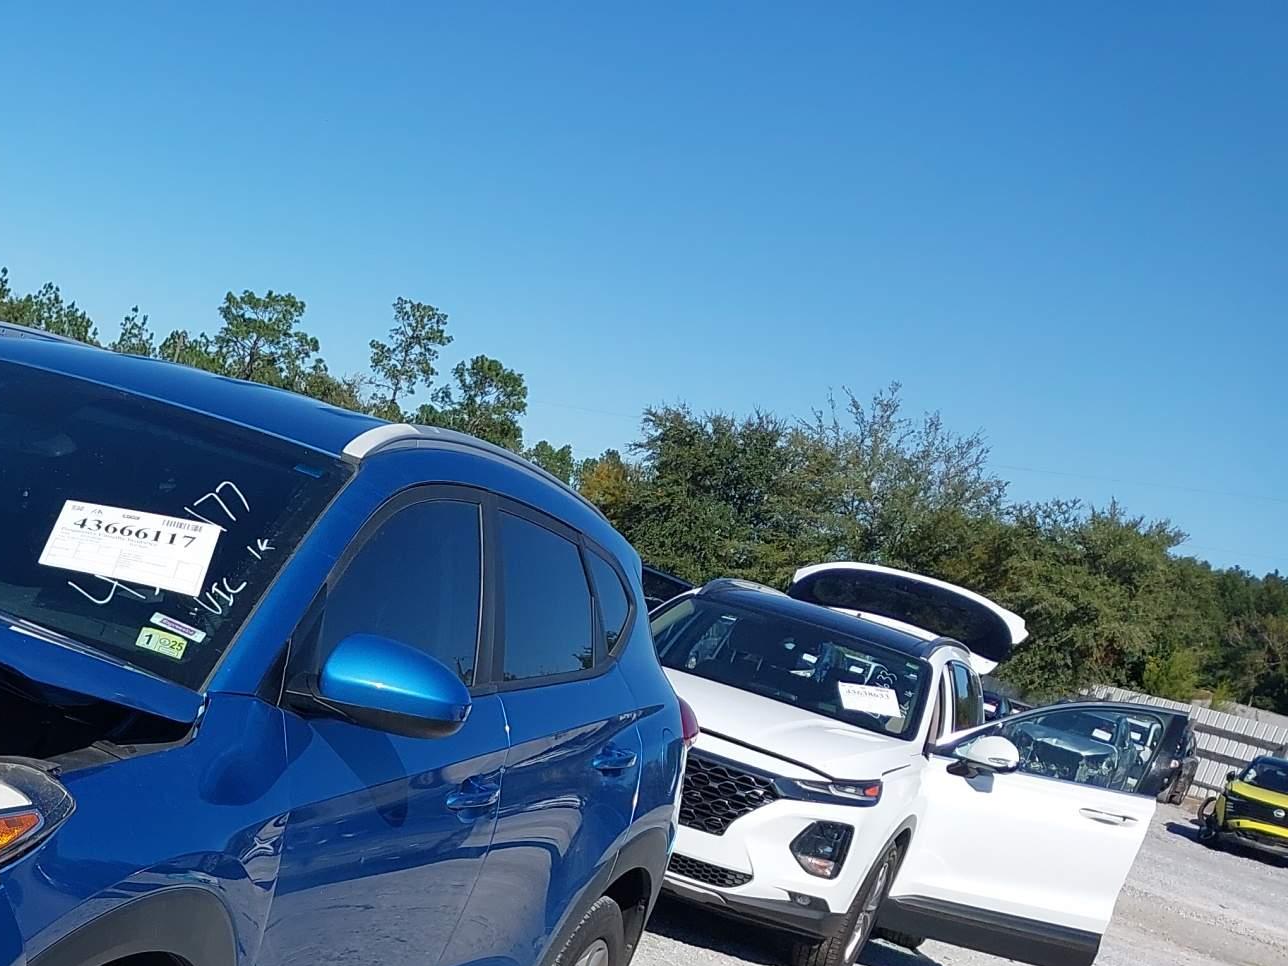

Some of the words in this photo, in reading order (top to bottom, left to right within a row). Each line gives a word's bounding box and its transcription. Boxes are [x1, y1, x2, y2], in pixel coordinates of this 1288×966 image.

[73, 517, 197, 548] 43666117
[144, 633, 153, 645] 1
[169, 640, 184, 651] 25
